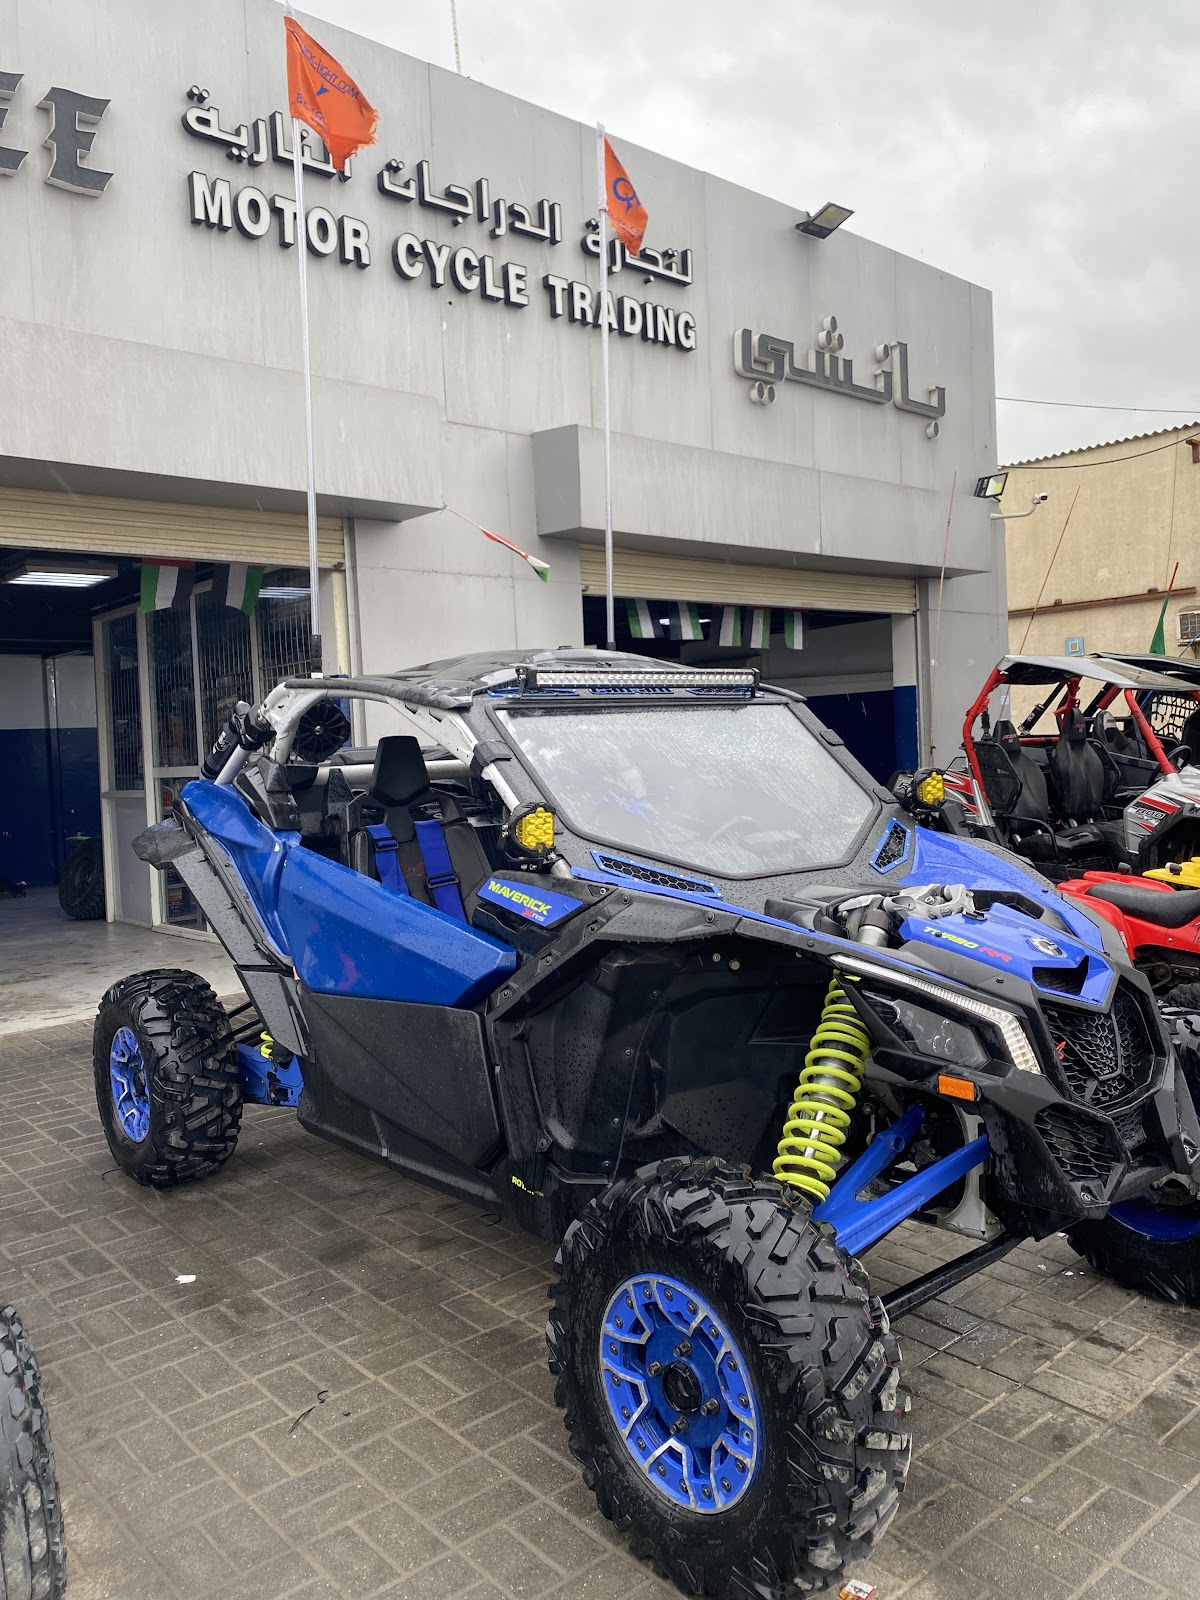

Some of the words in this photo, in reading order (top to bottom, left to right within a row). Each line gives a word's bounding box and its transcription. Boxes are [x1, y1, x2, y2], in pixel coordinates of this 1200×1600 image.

[377, 159, 562, 245] الدراجات
[187, 170, 371, 269] MOTOR
[392, 232, 529, 308] CYCLE
[543, 274, 696, 352] TRADING
[488, 881, 552, 916] MAVERICK
